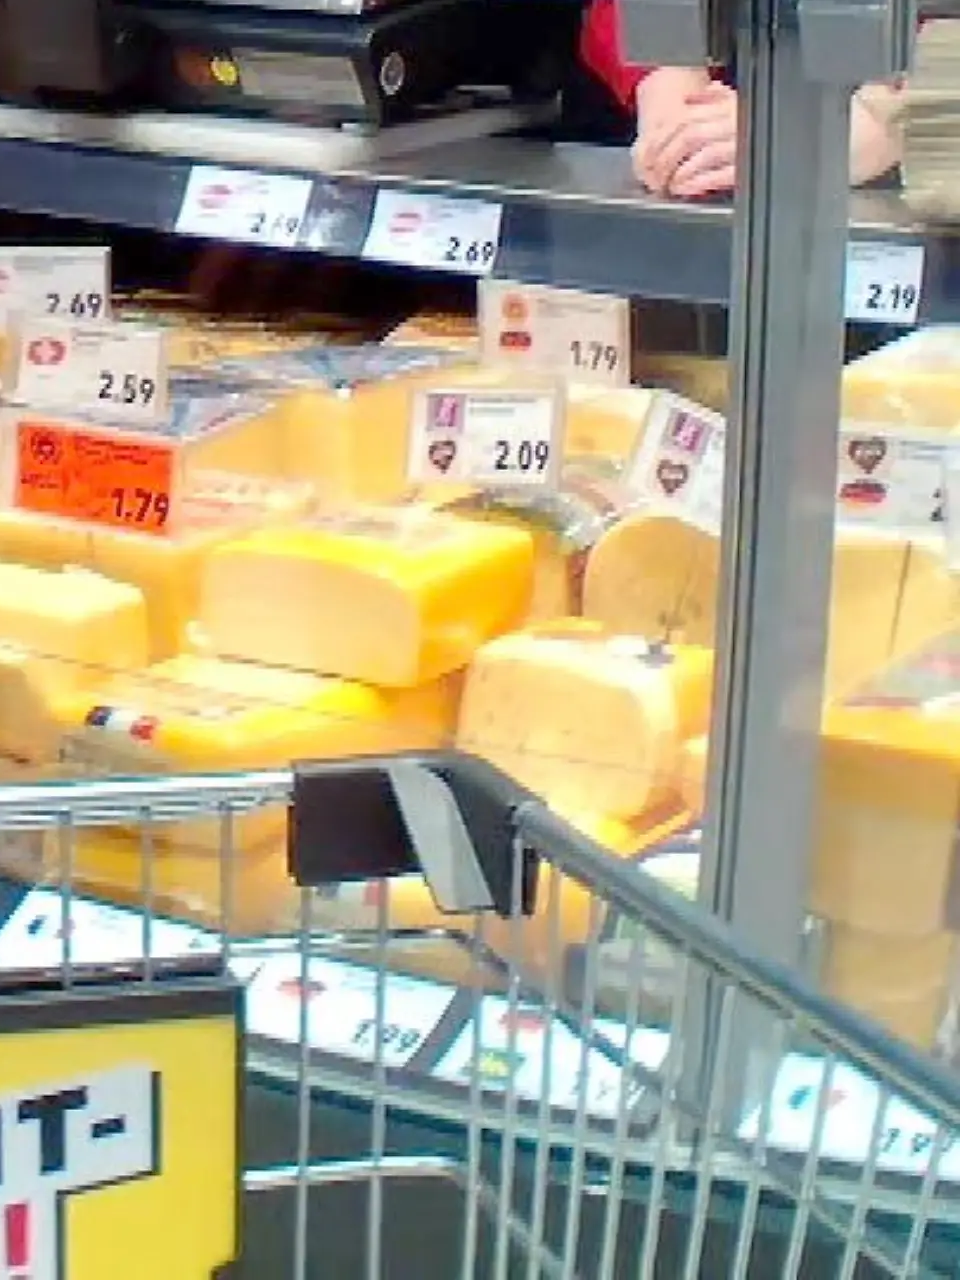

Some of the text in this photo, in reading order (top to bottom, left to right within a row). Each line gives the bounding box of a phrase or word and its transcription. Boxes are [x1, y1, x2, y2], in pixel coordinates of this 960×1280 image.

[866, 283, 916, 310] 2.19
[570, 340, 618, 371] 1.79
[97, 370, 155, 407] 2.59
[495, 439, 550, 473] 2.09
[110, 487, 170, 527] 1.79
